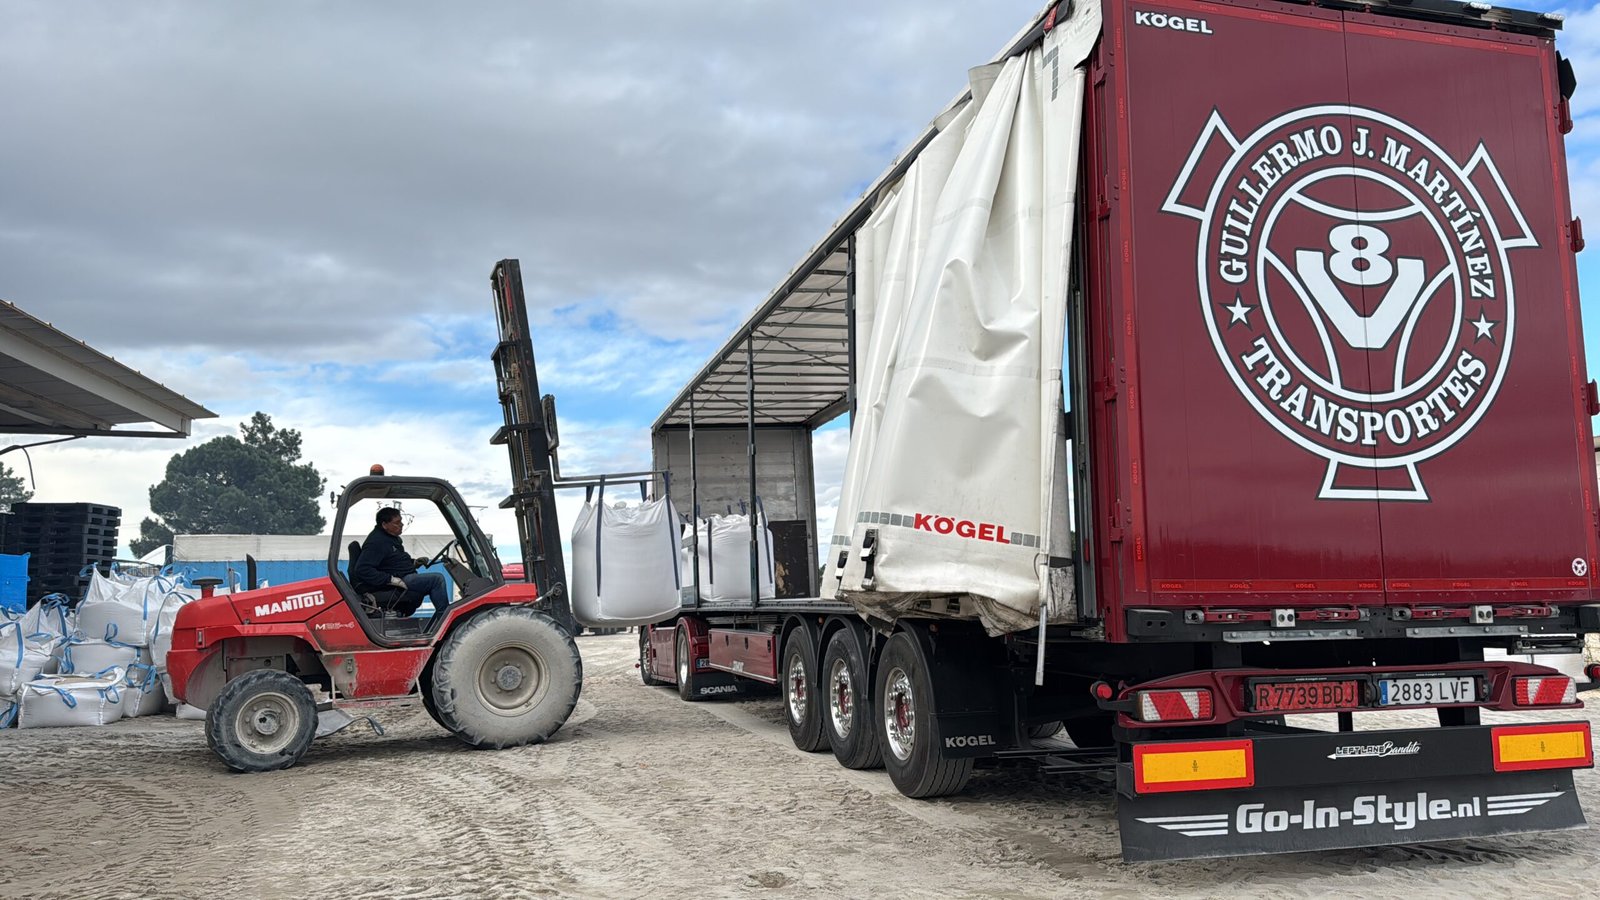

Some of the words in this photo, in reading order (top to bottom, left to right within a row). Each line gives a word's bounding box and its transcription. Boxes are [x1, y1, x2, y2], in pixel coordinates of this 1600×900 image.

[1135, 10, 1213, 34] KÖGEL
[1219, 124, 1343, 284] GUILLERMO
[1351, 126, 1375, 159] J.
[1380, 135, 1496, 299] MARTÍNEZ
[1240, 337, 1487, 446] TRANSPORTES
[913, 512, 1011, 544] KÖGEL
[254, 590, 325, 617] MANITOU
[700, 684, 738, 695] SCANIA
[1259, 687, 1270, 707] R
[1274, 686, 1319, 706] 7739
[1322, 685, 1355, 704] BDJ
[1391, 682, 1433, 702] 2883
[1439, 681, 1470, 700] LVF
[945, 734, 996, 748] KÖGEL
[1378, 740, 1422, 758] Bandito
[1236, 792, 1482, 831] Go-In-Style.nl
